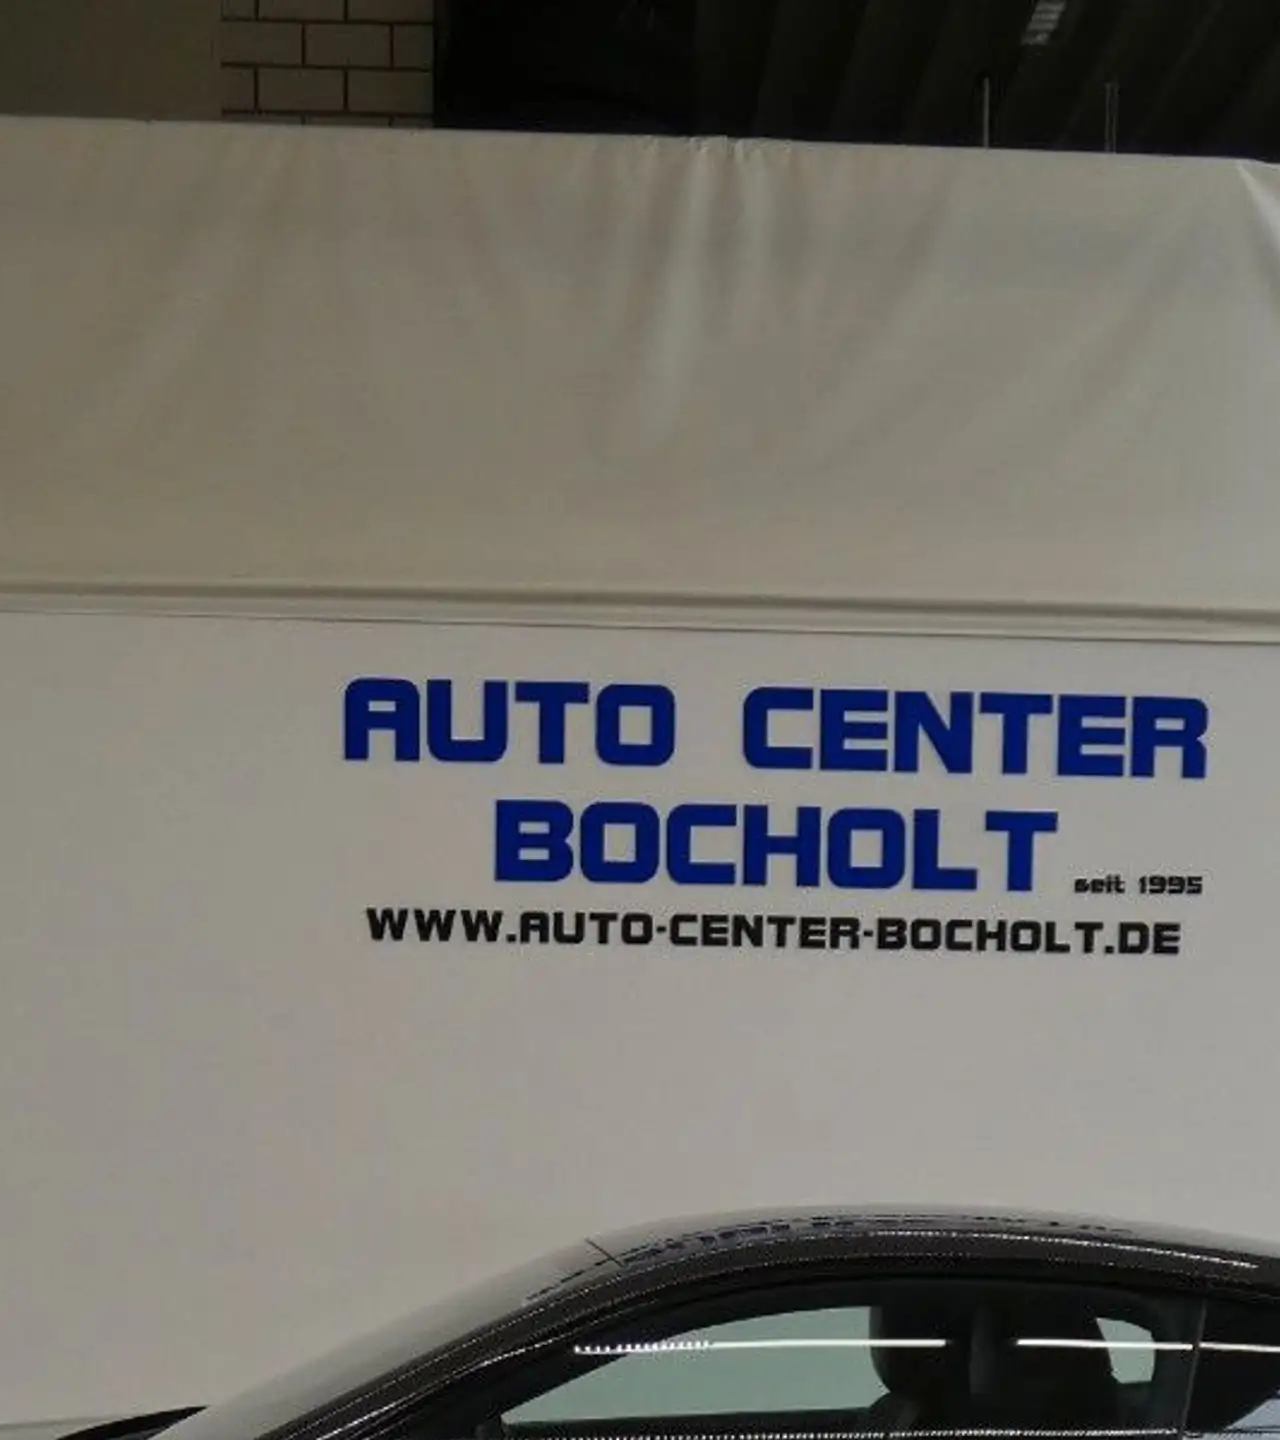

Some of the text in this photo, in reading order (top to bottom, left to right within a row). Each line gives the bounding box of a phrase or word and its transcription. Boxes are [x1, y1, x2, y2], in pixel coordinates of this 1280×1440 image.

[342, 676, 1210, 780] AUTO CENTER
[493, 798, 1203, 895] BOCHOLT seit 1995
[365, 907, 1182, 956] WWW.AUTO-CENTER-BOCHOLT.DE
